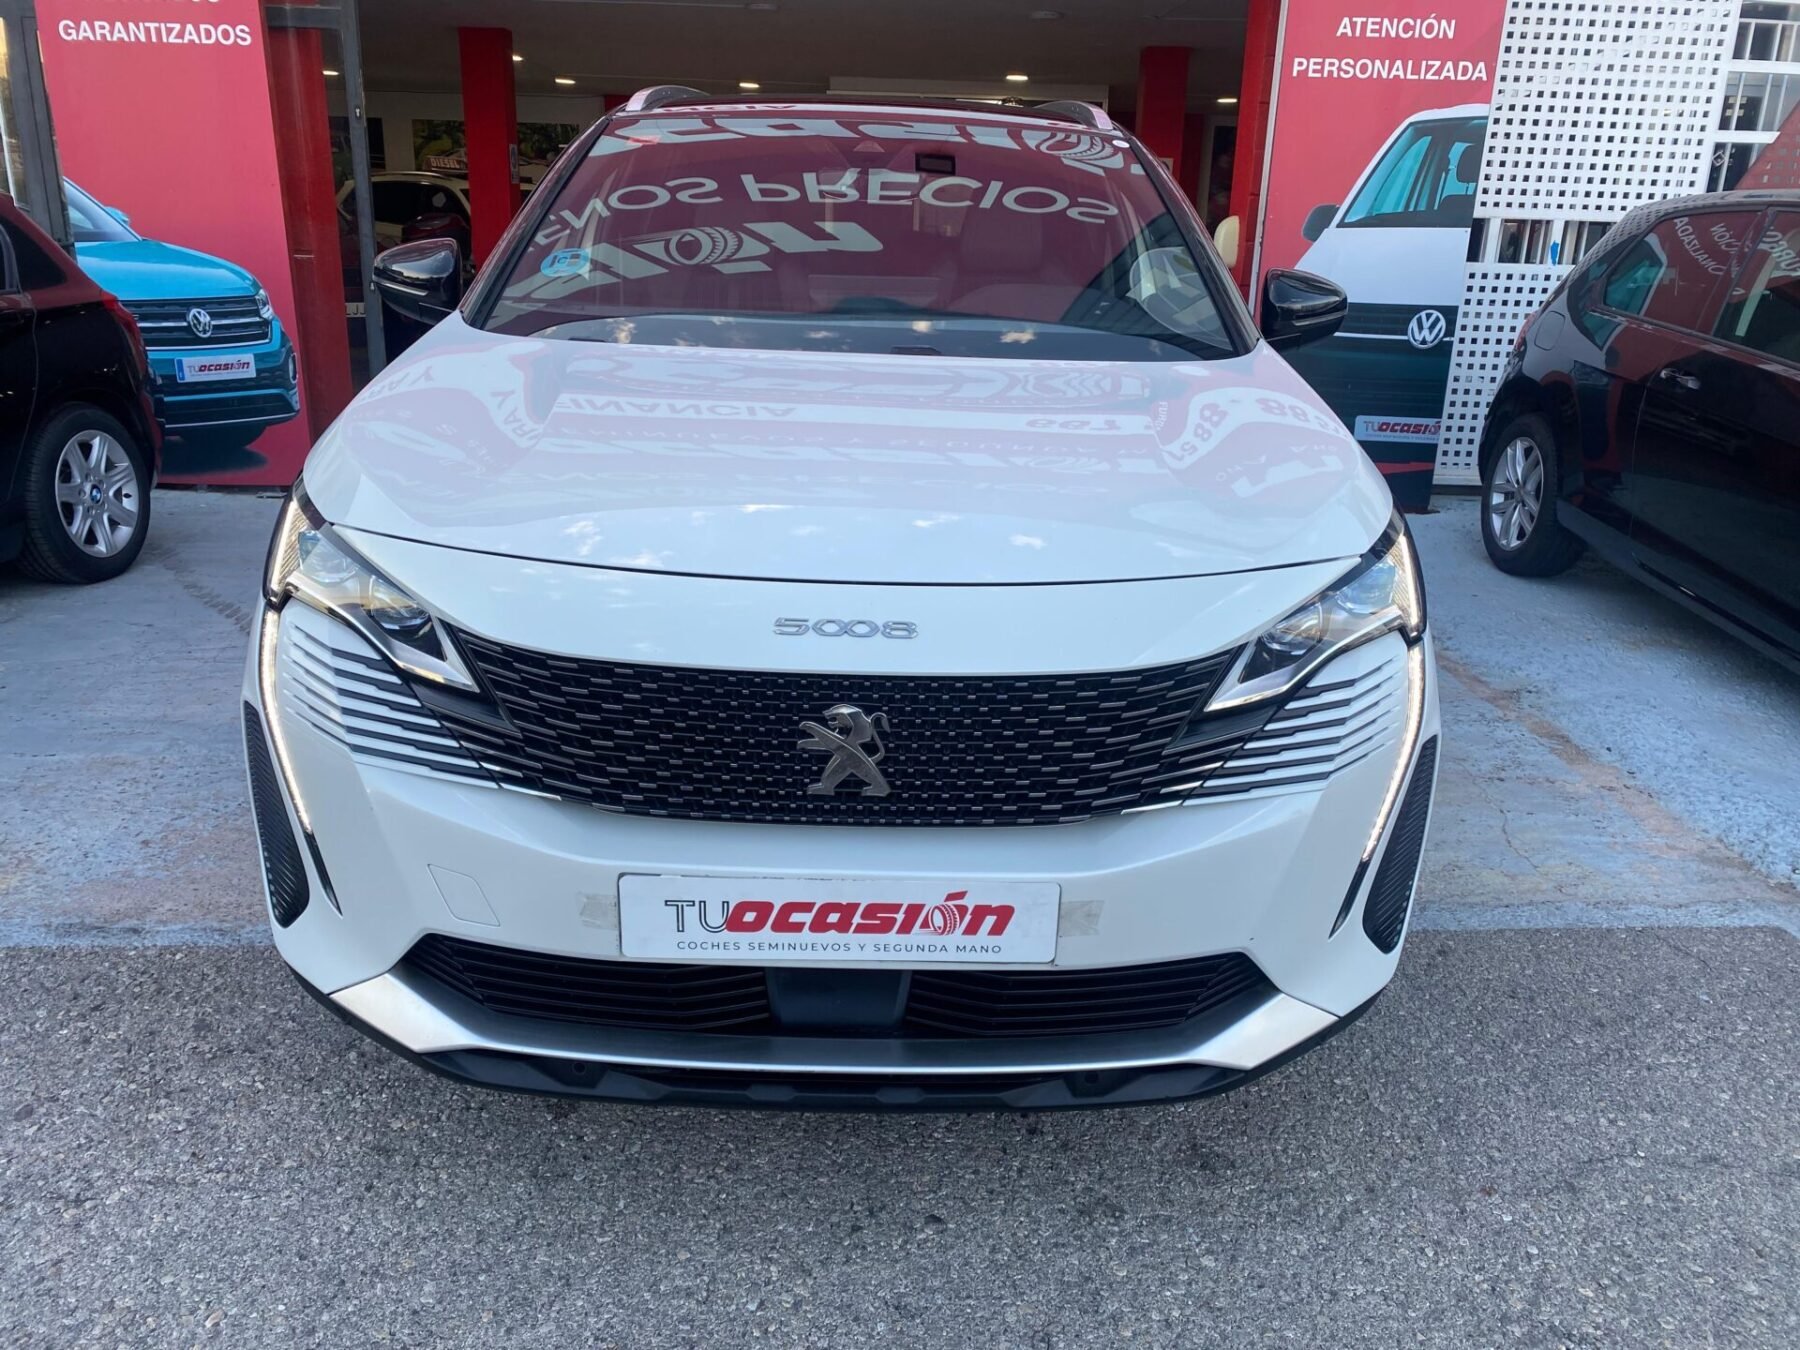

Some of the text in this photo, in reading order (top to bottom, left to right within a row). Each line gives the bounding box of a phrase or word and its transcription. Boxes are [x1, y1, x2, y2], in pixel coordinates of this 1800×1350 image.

[58, 20, 252, 45] GARANTIZADOS
[1336, 14, 1456, 39] ATENCIÓN
[1292, 58, 1488, 81] PERSONALIZADA
[430, 157, 460, 168] DIESEL
[773, 617, 919, 639] 5008
[677, 941, 1003, 954] COCHES SEMINUEVOS Y SEGUNDA MANO
